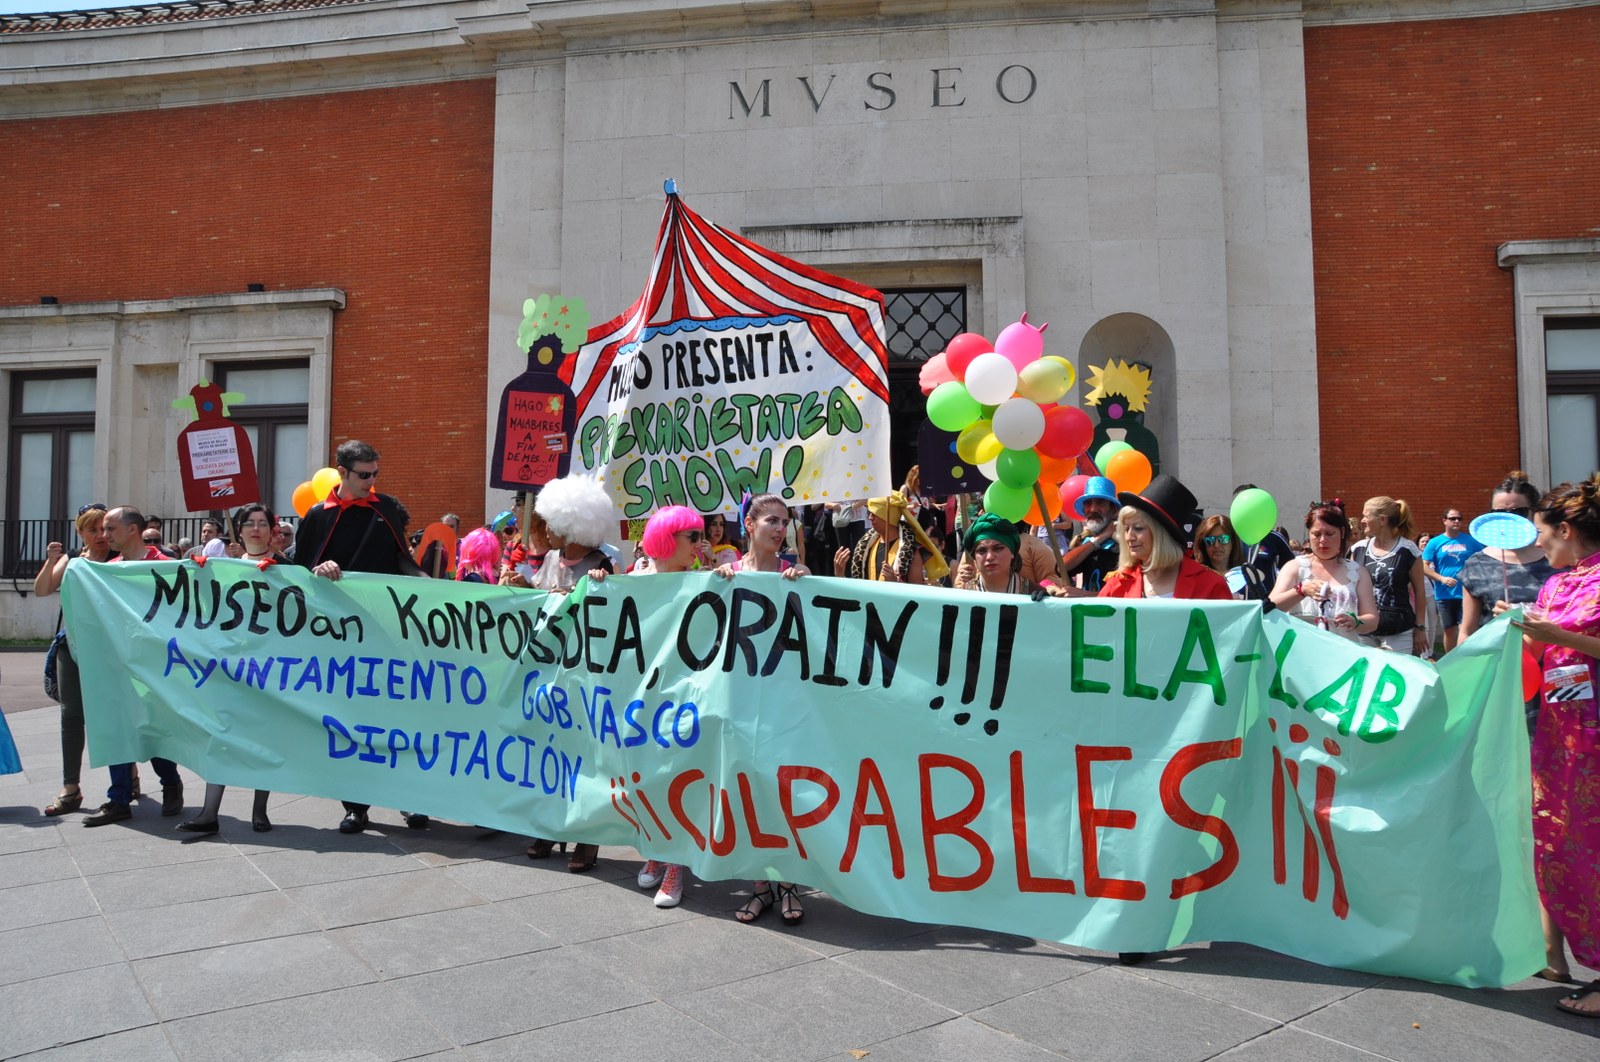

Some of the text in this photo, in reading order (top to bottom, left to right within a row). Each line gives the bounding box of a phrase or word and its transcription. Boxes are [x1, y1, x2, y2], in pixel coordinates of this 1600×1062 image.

[728, 64, 1037, 119] MVSEO
[662, 330, 813, 390] PRESENTA:
[514, 397, 544, 412] HAGO
[509, 417, 561, 432] MALABARES
[523, 432, 532, 442] A
[516, 442, 537, 452] FIN
[507, 452, 520, 461] DE
[623, 444, 804, 518] SHOW!
